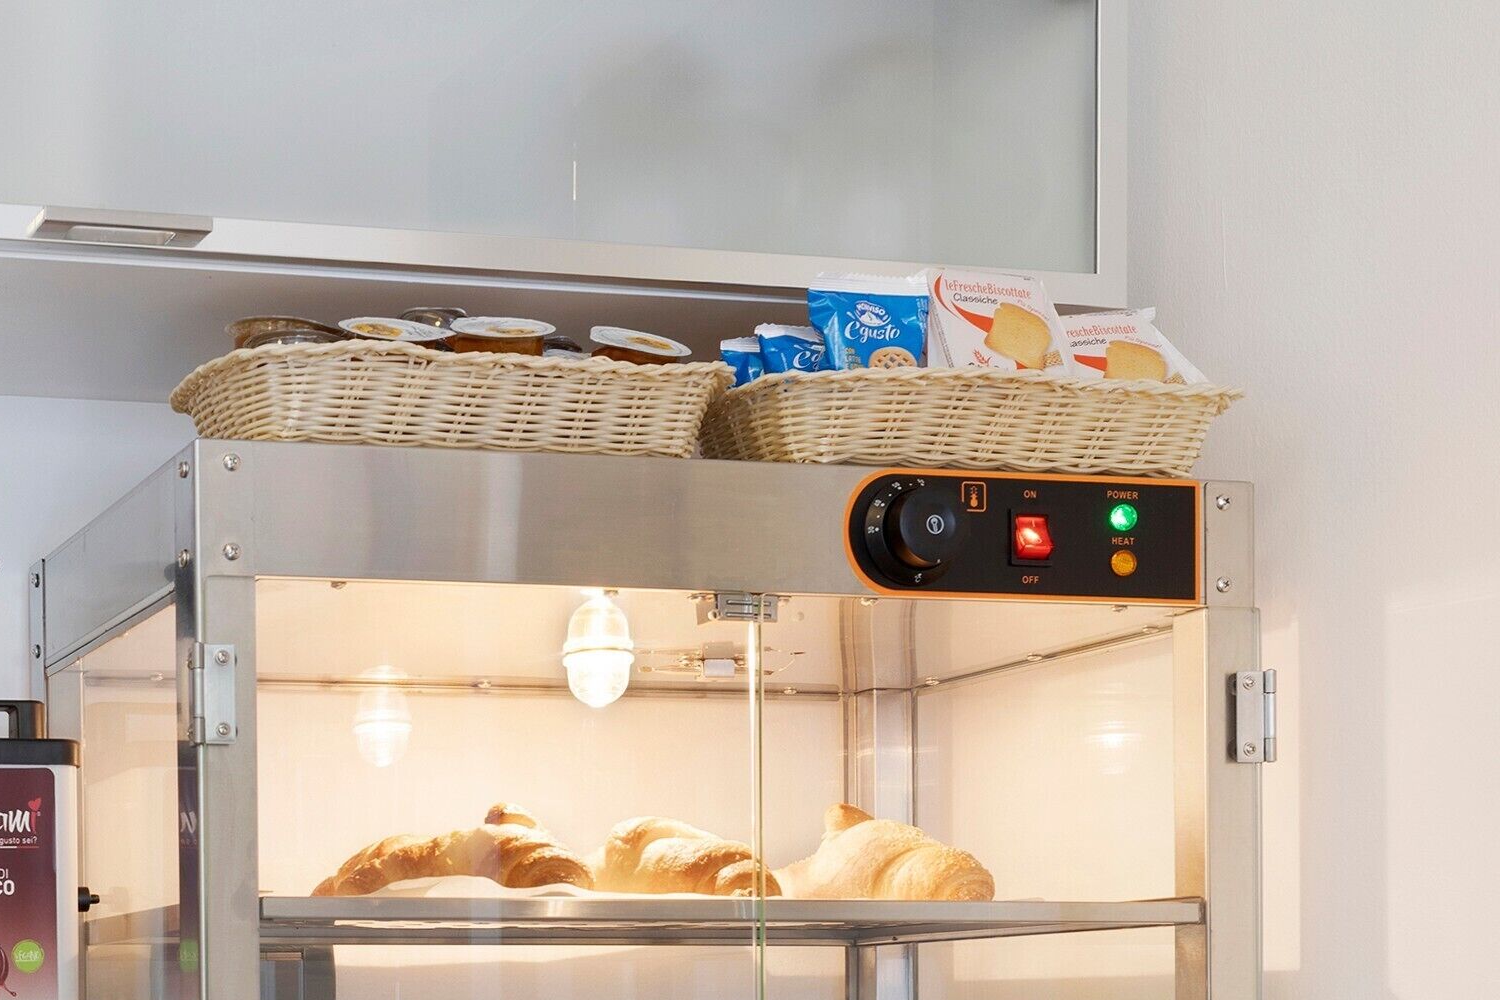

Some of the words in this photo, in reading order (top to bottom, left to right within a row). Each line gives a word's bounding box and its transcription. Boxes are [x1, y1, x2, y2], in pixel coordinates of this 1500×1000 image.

[953, 293, 998, 304] Classiche
[1023, 489, 1037, 499] ON
[1106, 490, 1139, 500] POWER
[1111, 537, 1135, 546] HEAT
[1022, 575, 1039, 584] OFF
[22, 836, 38, 844] sei?
